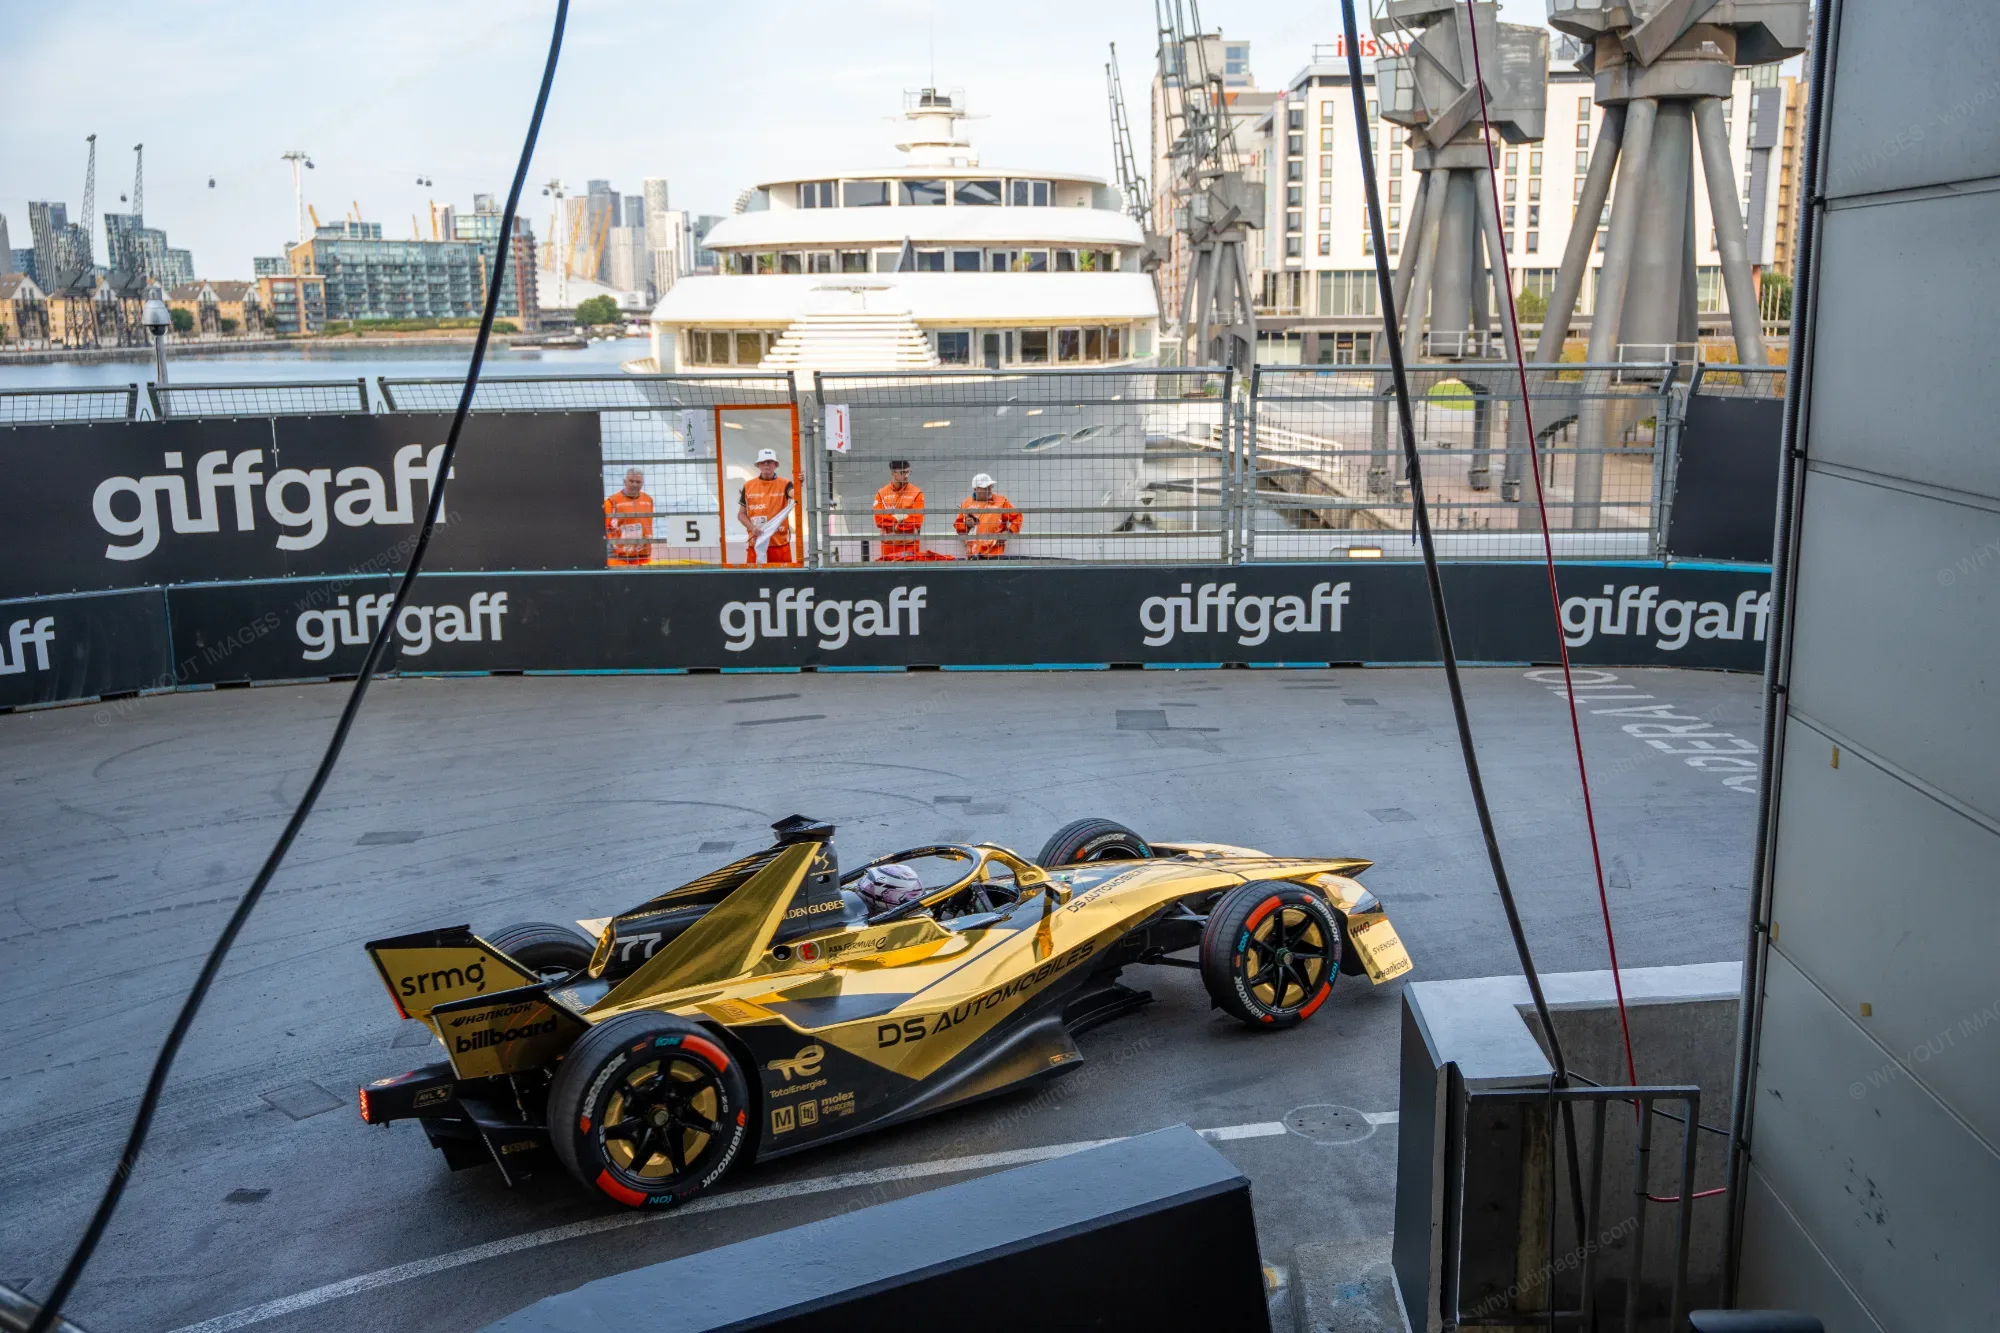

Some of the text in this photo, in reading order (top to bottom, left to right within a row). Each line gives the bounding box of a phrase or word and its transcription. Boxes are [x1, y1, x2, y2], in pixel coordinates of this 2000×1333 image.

[1337, 34, 1377, 57] iis
[92, 444, 456, 561] giffgaff
[685, 521, 700, 542] 5
[296, 591, 508, 661] giffgaff
[720, 586, 927, 652] giffgaff
[1139, 581, 1350, 647] giffgaff
[808, 900, 845, 915] GLOBES
[616, 932, 662, 962] 77
[802, 942, 815, 961] E
[401, 956, 486, 997] srmg
[878, 938, 1096, 1048] DS AUTOMOBILES
[456, 1014, 557, 1054] billboard
[769, 1078, 828, 1098] TotalEnergies
[821, 1091, 855, 1106] molex
